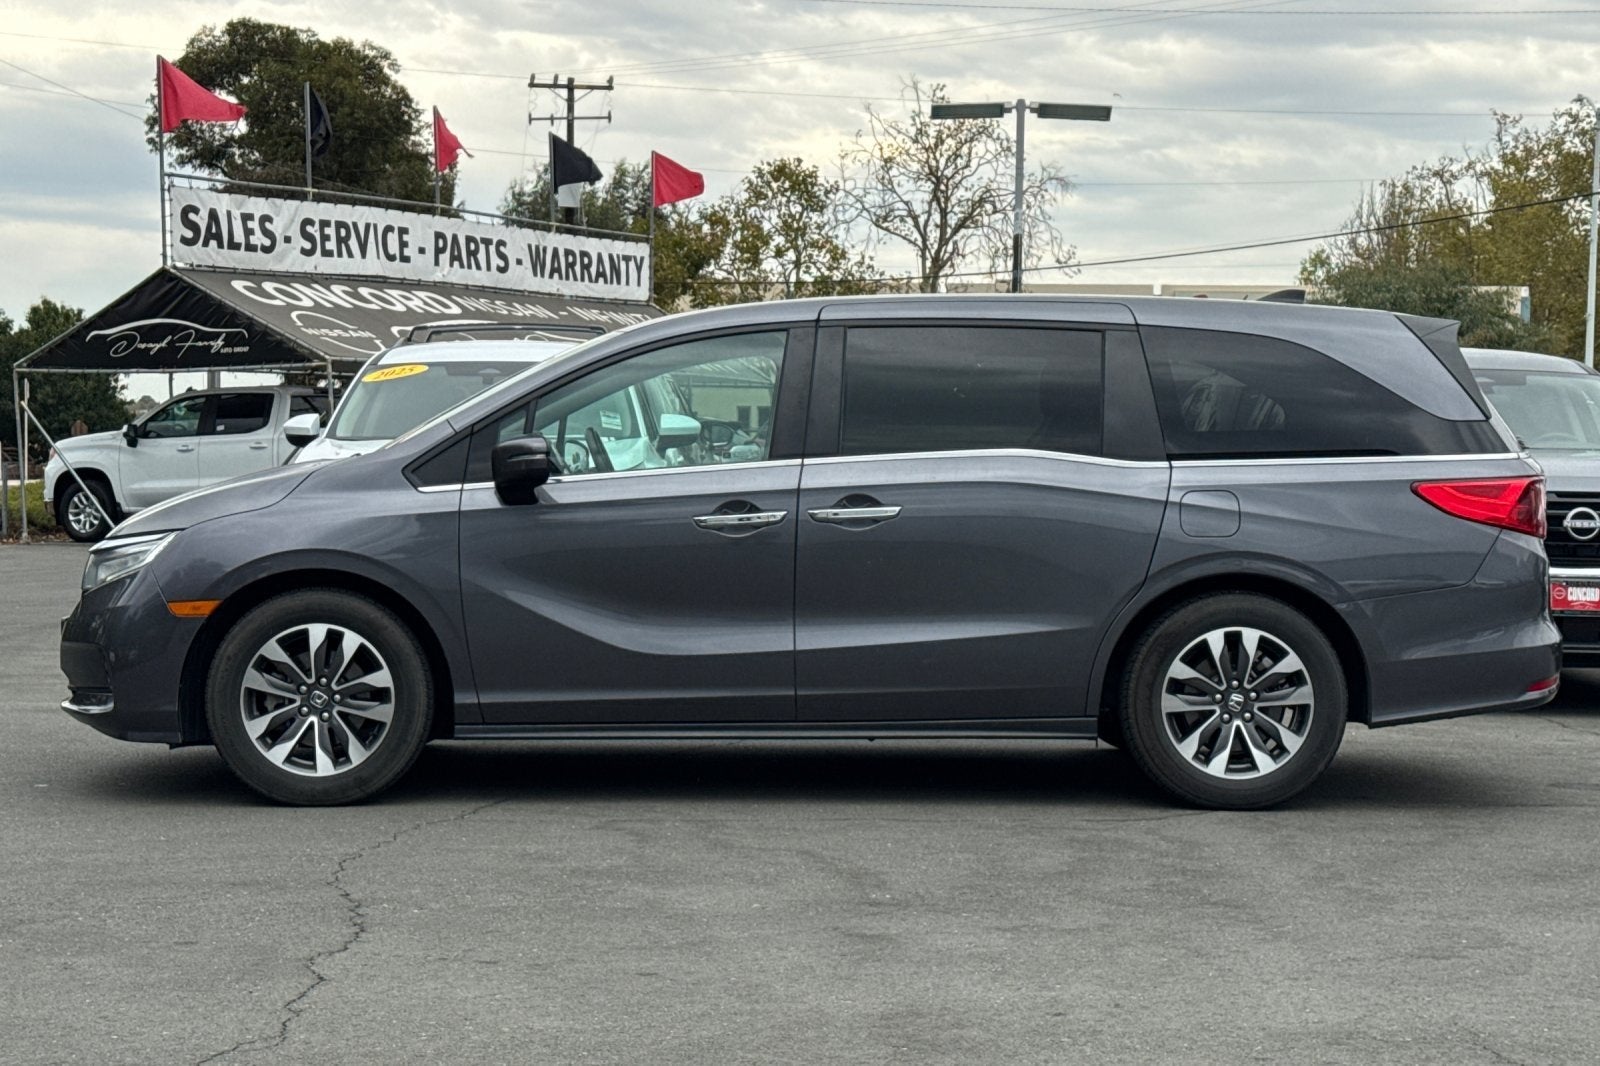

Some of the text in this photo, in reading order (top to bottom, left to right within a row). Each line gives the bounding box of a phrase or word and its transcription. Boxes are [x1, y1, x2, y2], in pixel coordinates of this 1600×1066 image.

[179, 204, 277, 255] SALES
[299, 217, 411, 264] SERVICE
[433, 230, 510, 274] PARTS
[527, 243, 645, 288] WARRANTY
[230, 279, 463, 315] CONCORD
[451, 295, 560, 320] NISSAN
[299, 326, 377, 339] NISSAN
[372, 365, 418, 381] 2025
[1567, 587, 1600, 601] CONCORD
